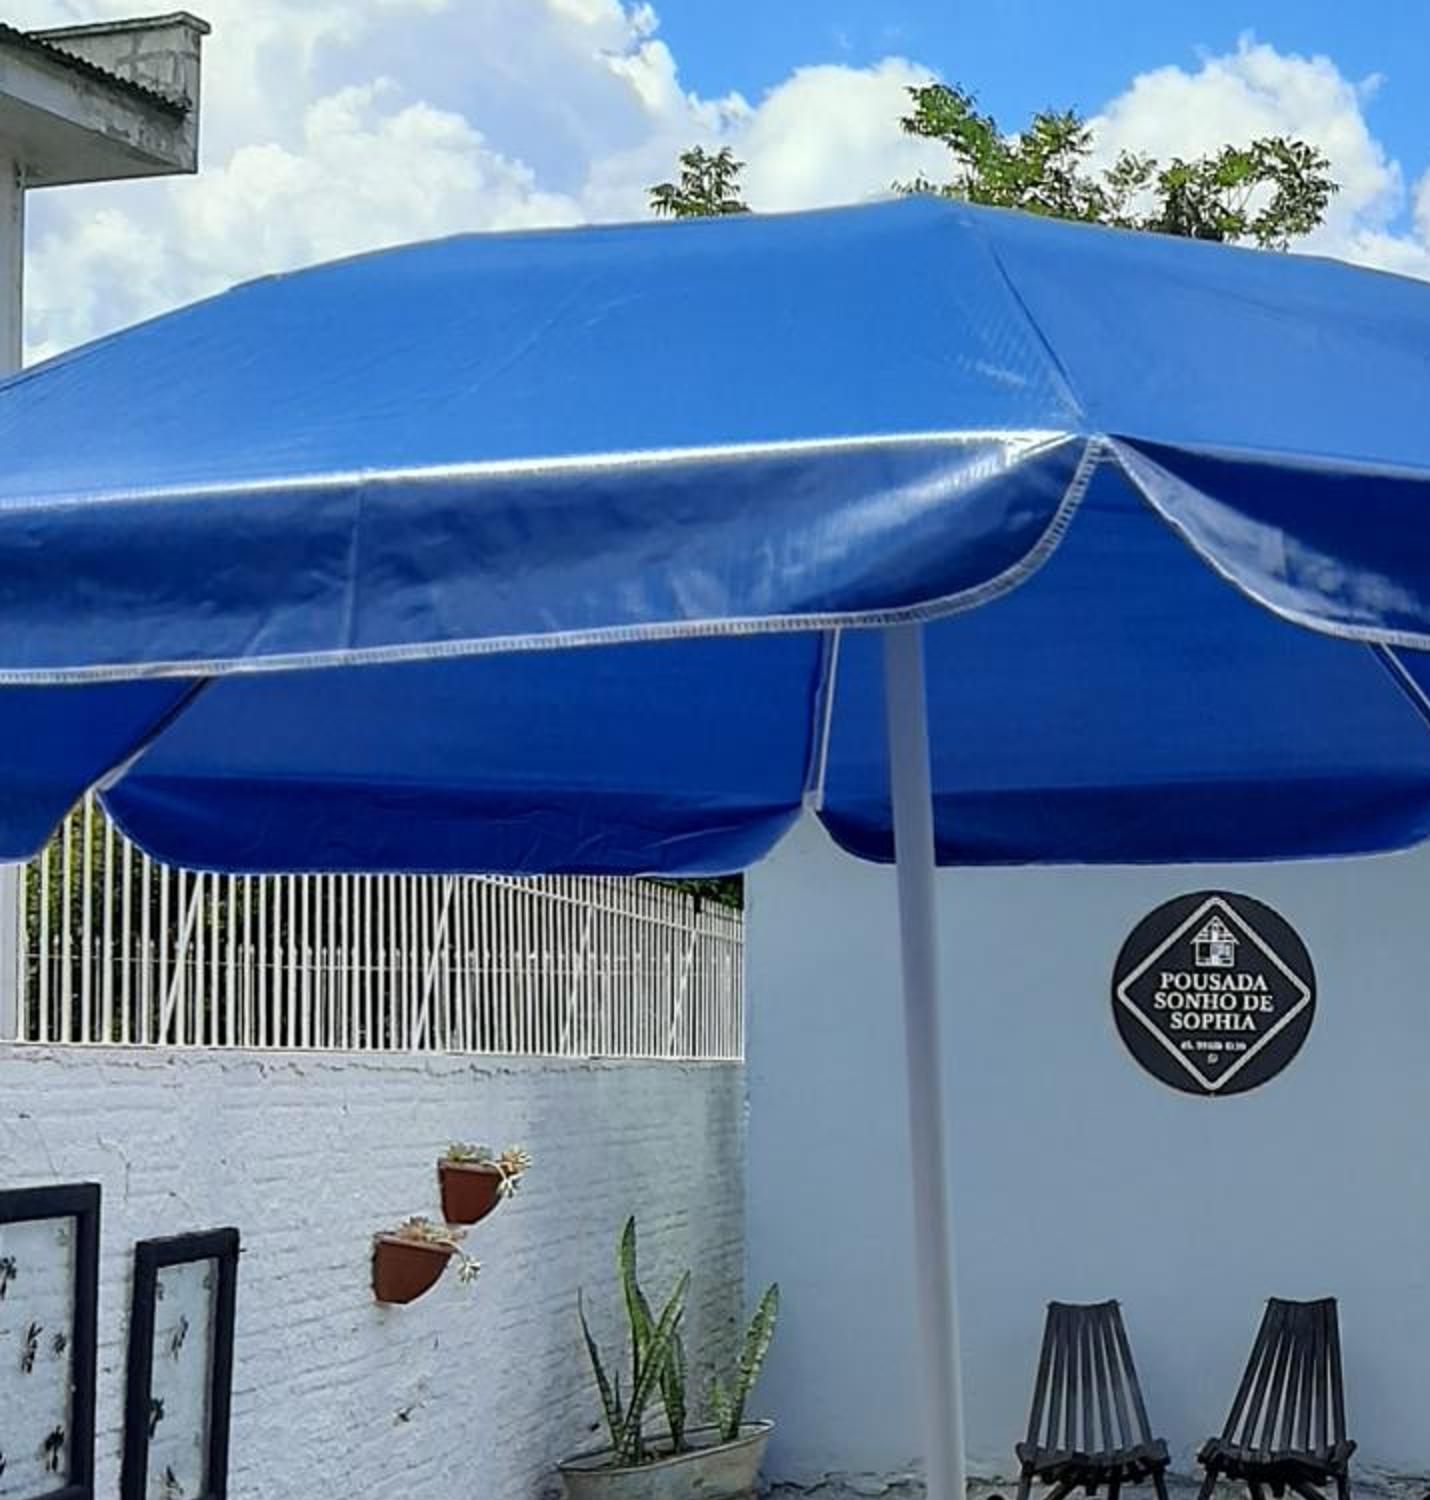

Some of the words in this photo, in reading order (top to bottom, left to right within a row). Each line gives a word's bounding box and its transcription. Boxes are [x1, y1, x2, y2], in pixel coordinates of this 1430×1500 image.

[1160, 972, 1268, 991] POUSADA
[1153, 991, 1237, 1011] SONHO
[1242, 994, 1274, 1012] DE
[1170, 1011, 1256, 1031] SOPHIA
